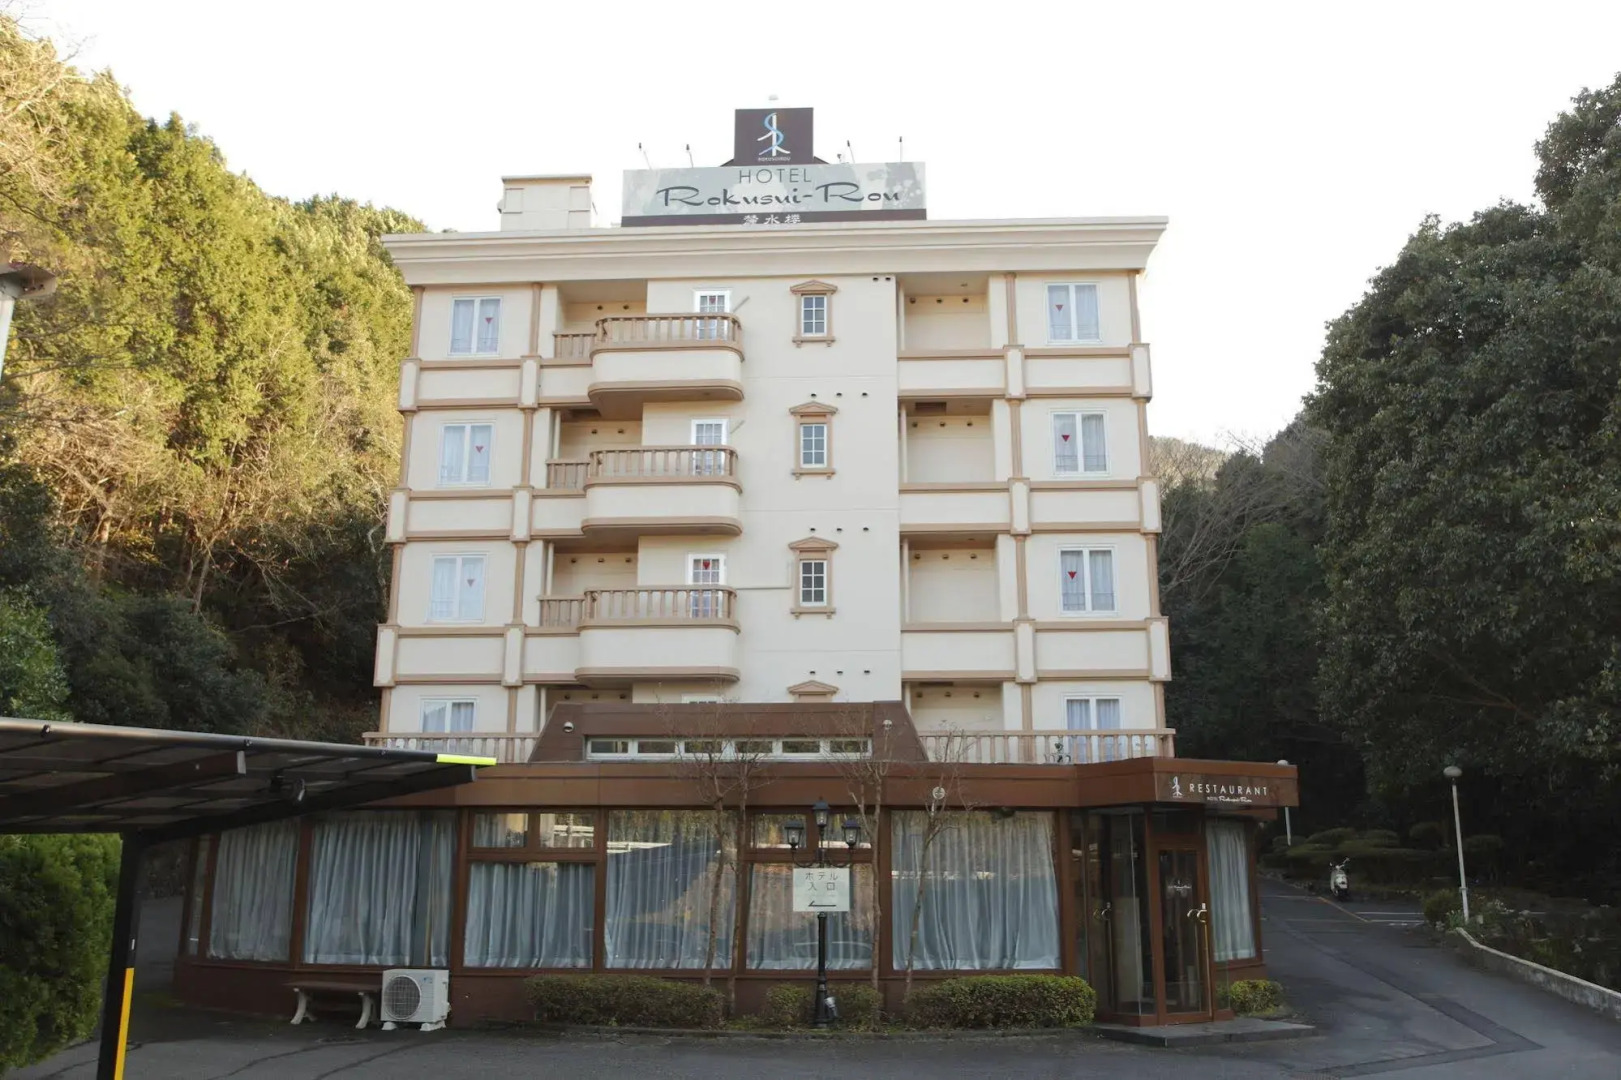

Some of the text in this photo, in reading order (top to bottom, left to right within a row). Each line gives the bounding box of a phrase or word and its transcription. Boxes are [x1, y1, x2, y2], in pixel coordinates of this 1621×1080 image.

[739, 168, 812, 184] HOTEL
[656, 181, 901, 207] Rokusui-Rou
[1189, 783, 1267, 796] RESTAURANT
[805, 872, 838, 881] ホテル
[808, 882, 835, 891] 入口
